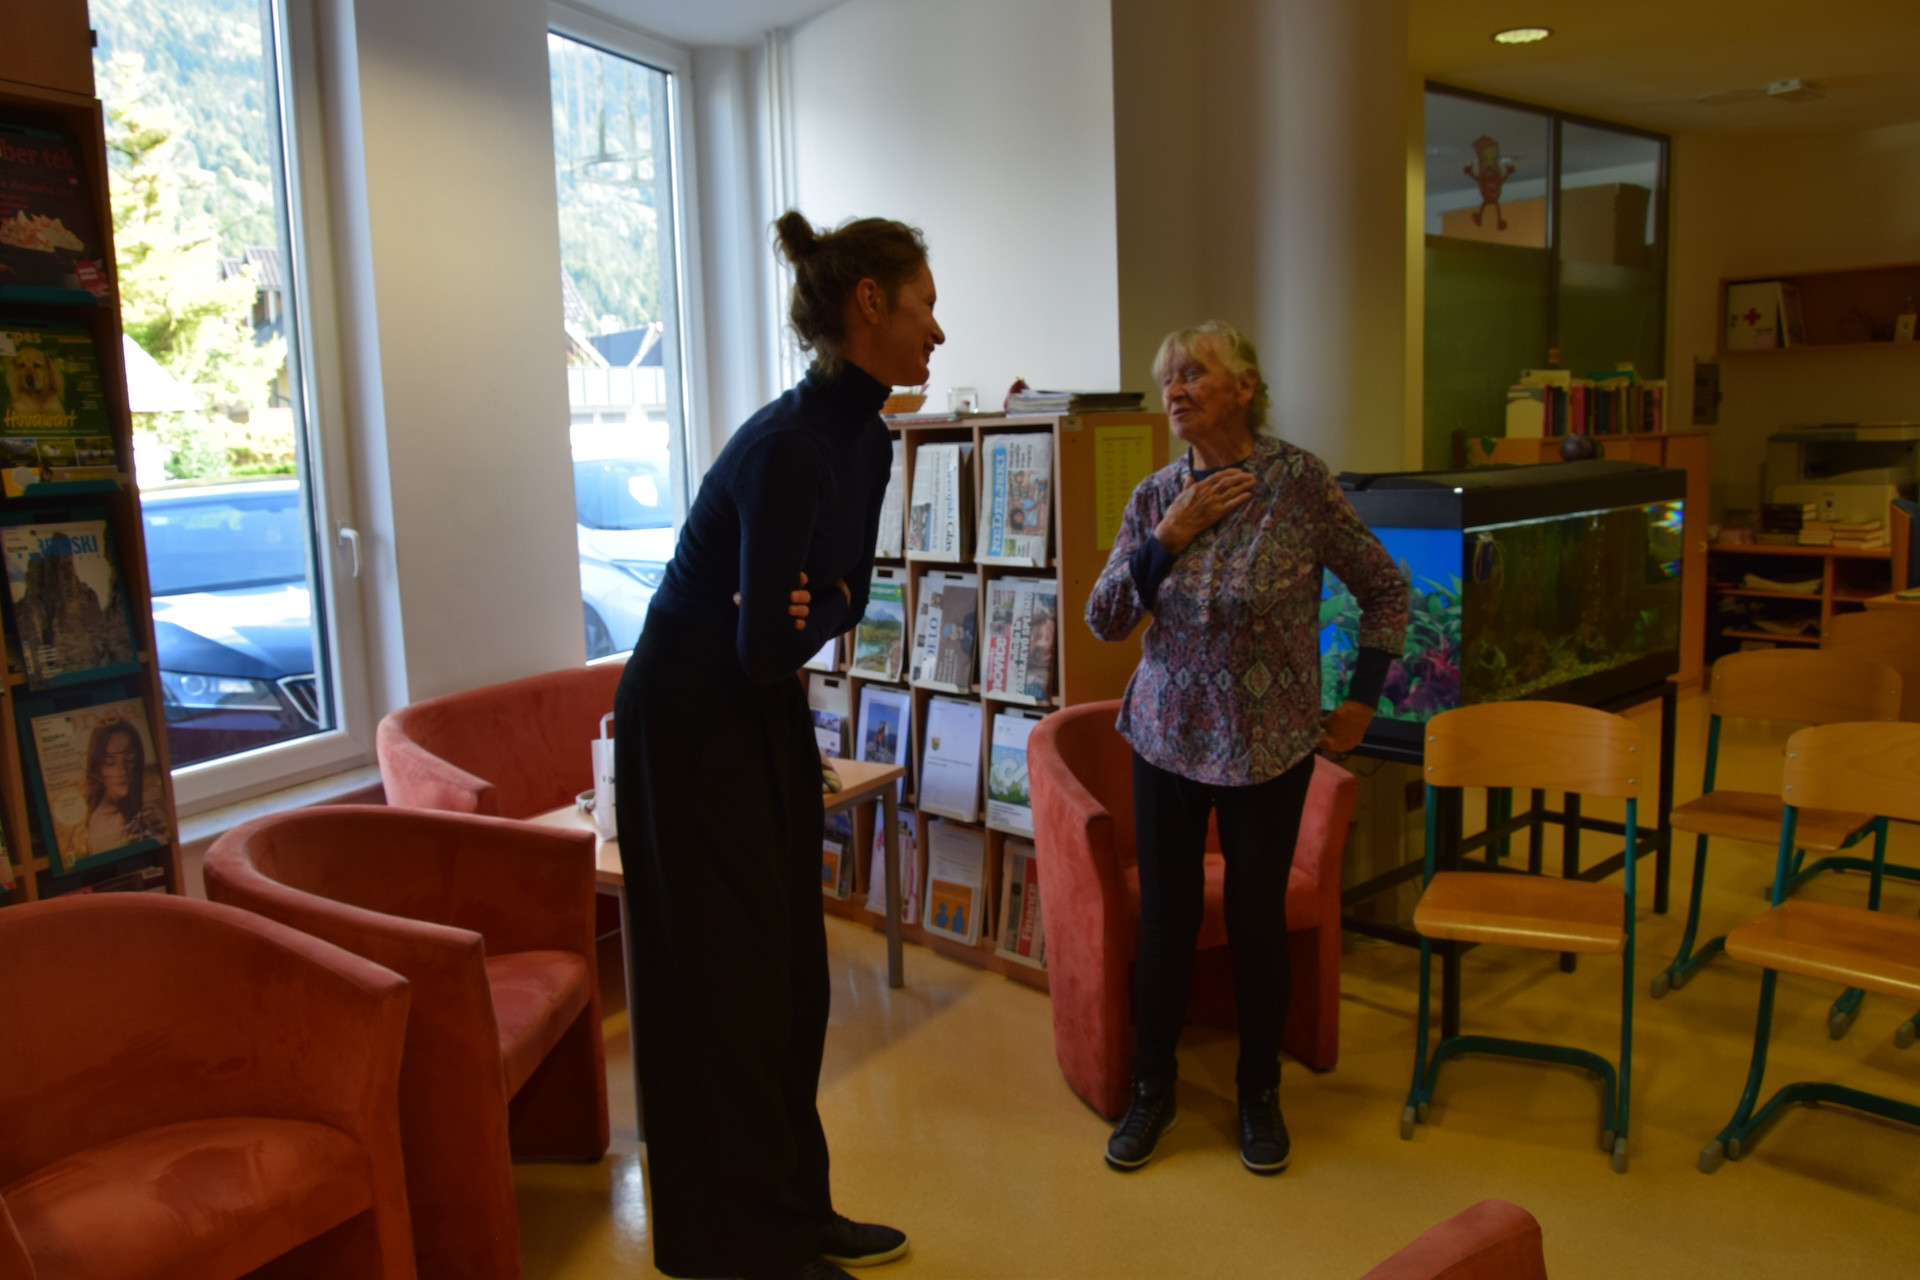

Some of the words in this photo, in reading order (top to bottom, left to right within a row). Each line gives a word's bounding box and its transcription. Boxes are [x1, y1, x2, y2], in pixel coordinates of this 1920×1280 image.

[13, 331, 42, 346] pes
[991, 453, 1005, 553] NEDELJSKI
[945, 521, 954, 552] Glas
[1021, 883, 1036, 942] Finance
